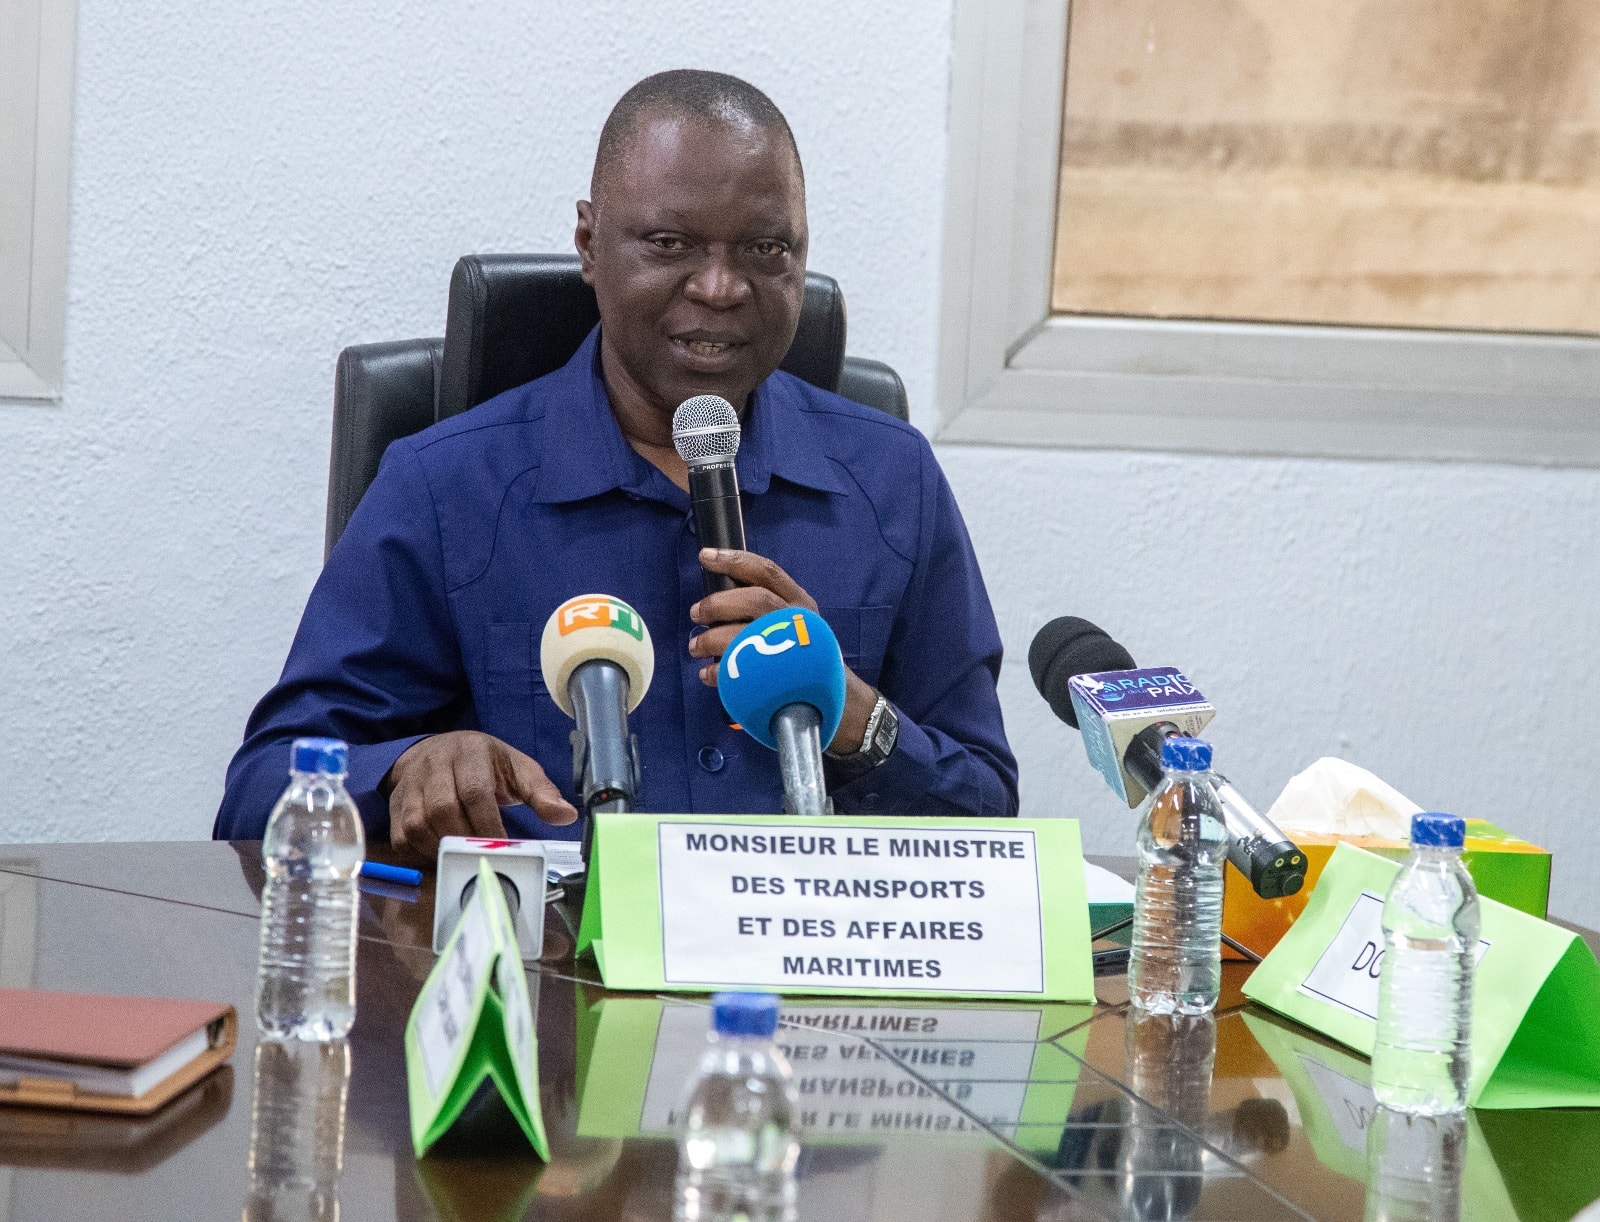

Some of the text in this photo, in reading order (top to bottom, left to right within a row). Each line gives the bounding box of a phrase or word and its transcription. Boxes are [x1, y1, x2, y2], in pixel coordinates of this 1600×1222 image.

[564, 603, 640, 632] RTI
[1117, 674, 1190, 690] RADIO
[686, 833, 1026, 860] MONSIEUR LE MINISTRE
[731, 876, 986, 899] DES TRANSPORTS
[737, 917, 984, 941] ET DES AFFAIRES
[782, 956, 942, 979] MARITIMES
